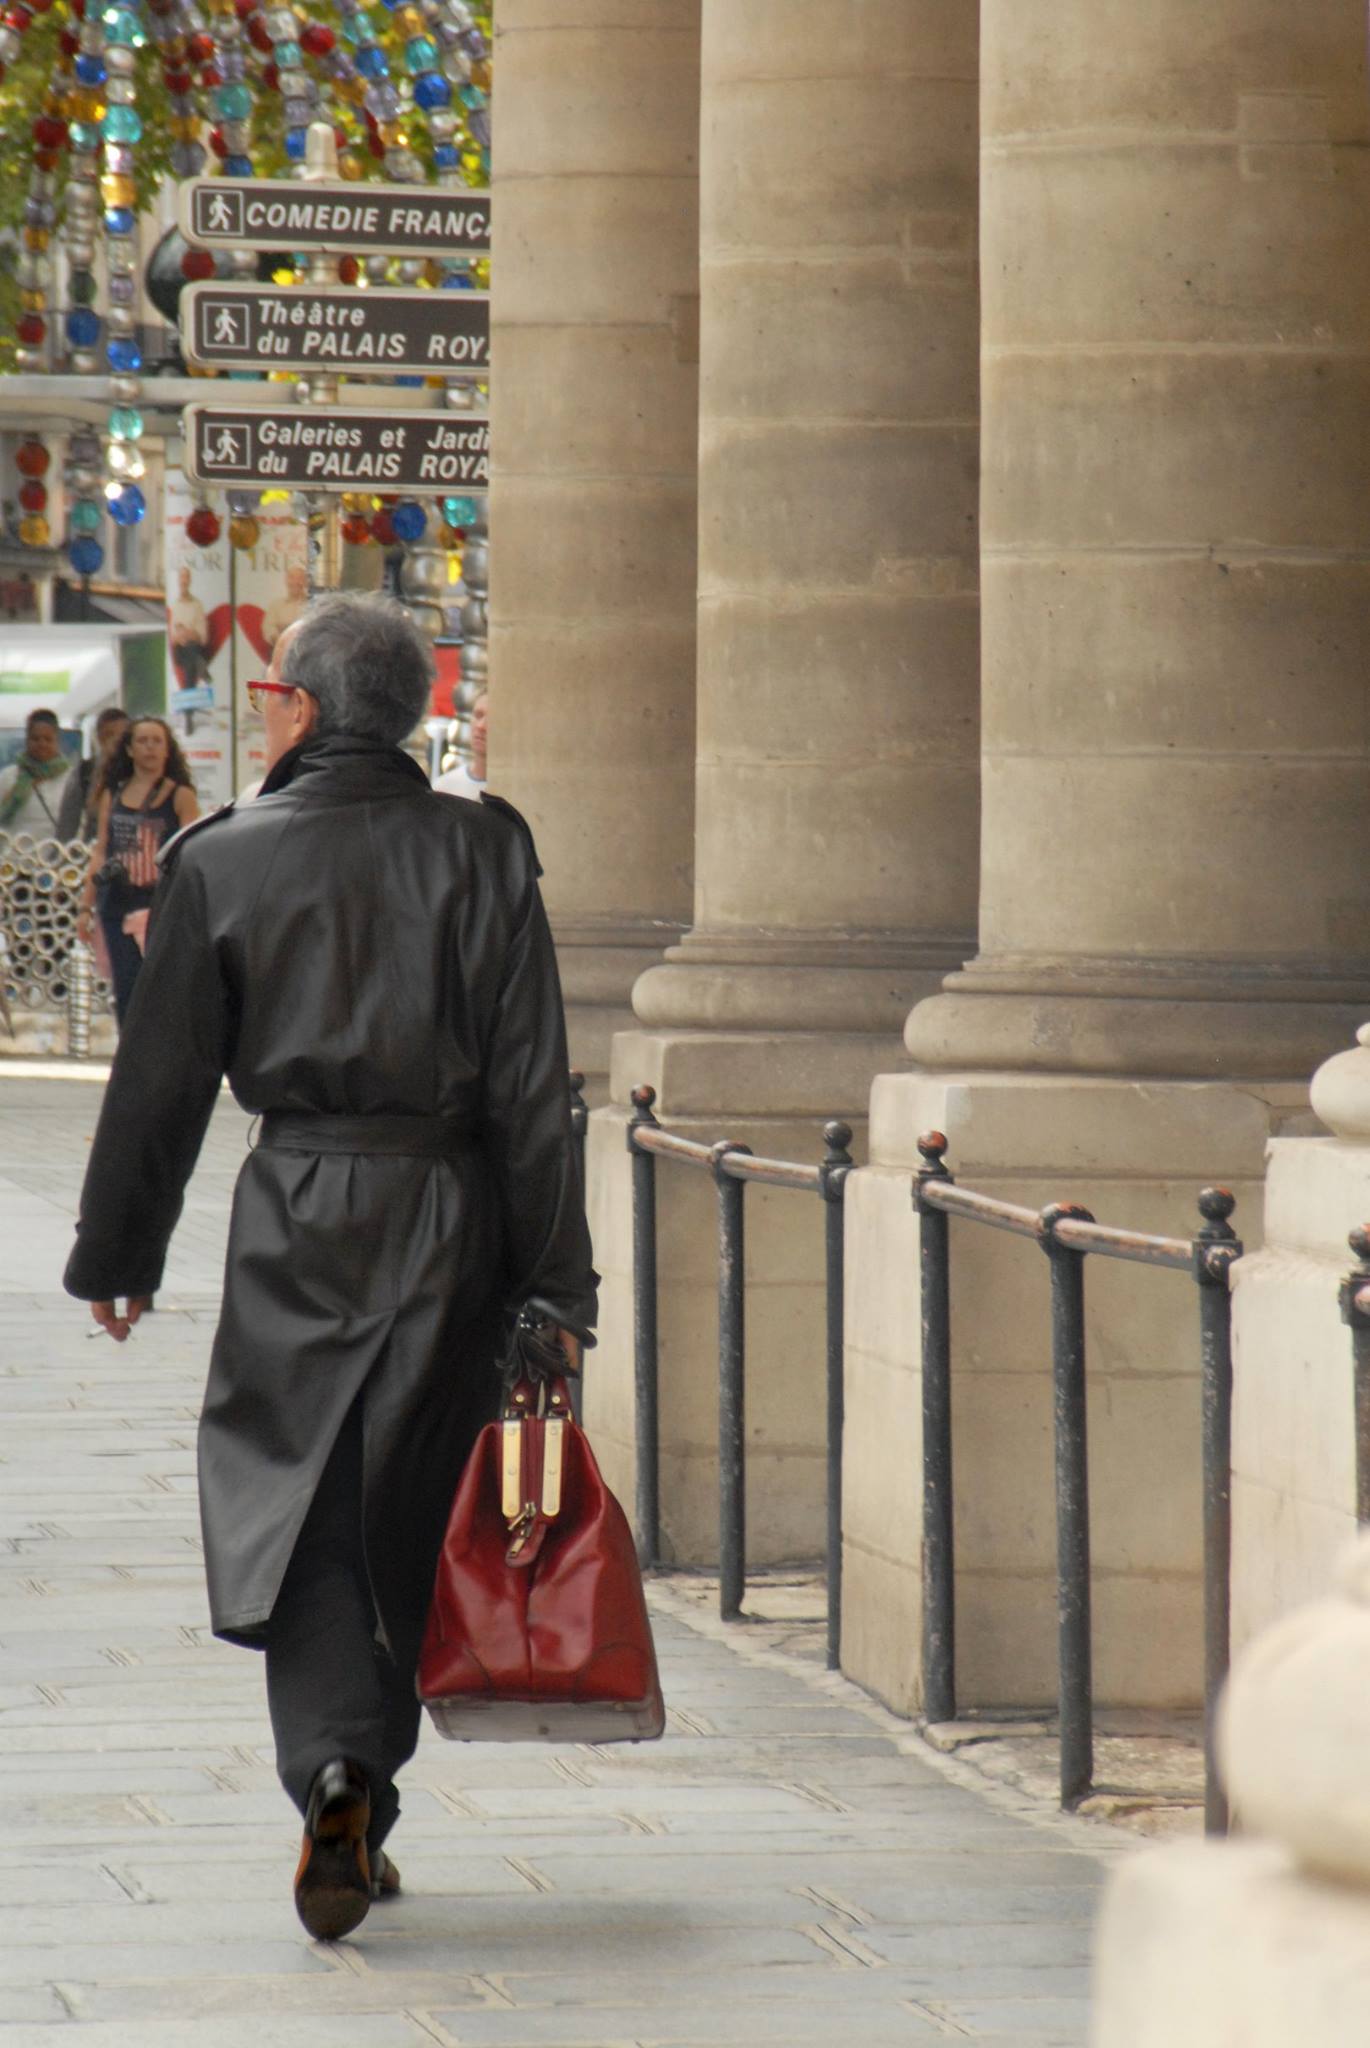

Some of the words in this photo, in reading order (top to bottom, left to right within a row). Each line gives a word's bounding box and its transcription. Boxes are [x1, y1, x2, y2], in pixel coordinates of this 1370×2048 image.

[246, 202, 380, 233] COMEDIE
[387, 208, 491, 237] FRANÇ
[257, 298, 366, 328] Théâtre
[257, 330, 291, 355] du
[302, 333, 407, 358] PALAIS
[427, 335, 490, 361] ROY
[257, 420, 362, 448] Galeries
[380, 426, 406, 449] et
[257, 450, 289, 475] du
[306, 452, 401, 477] PALAIS
